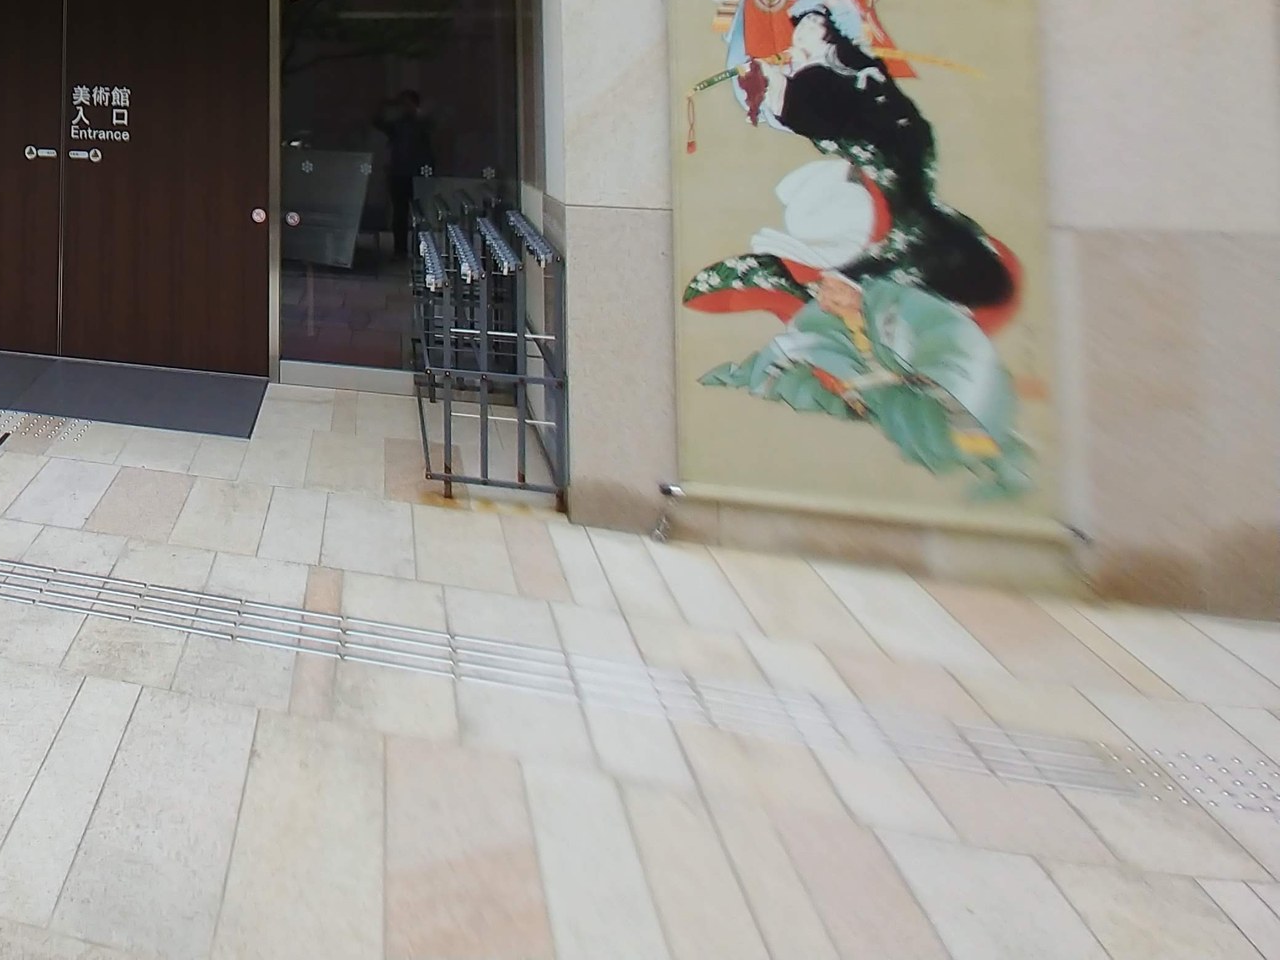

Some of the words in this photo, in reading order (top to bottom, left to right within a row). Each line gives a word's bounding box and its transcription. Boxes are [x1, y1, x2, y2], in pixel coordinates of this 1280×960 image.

[72, 85, 131, 107] 美術館
[71, 106, 129, 127] 入口
[70, 125, 130, 141] Entrance
